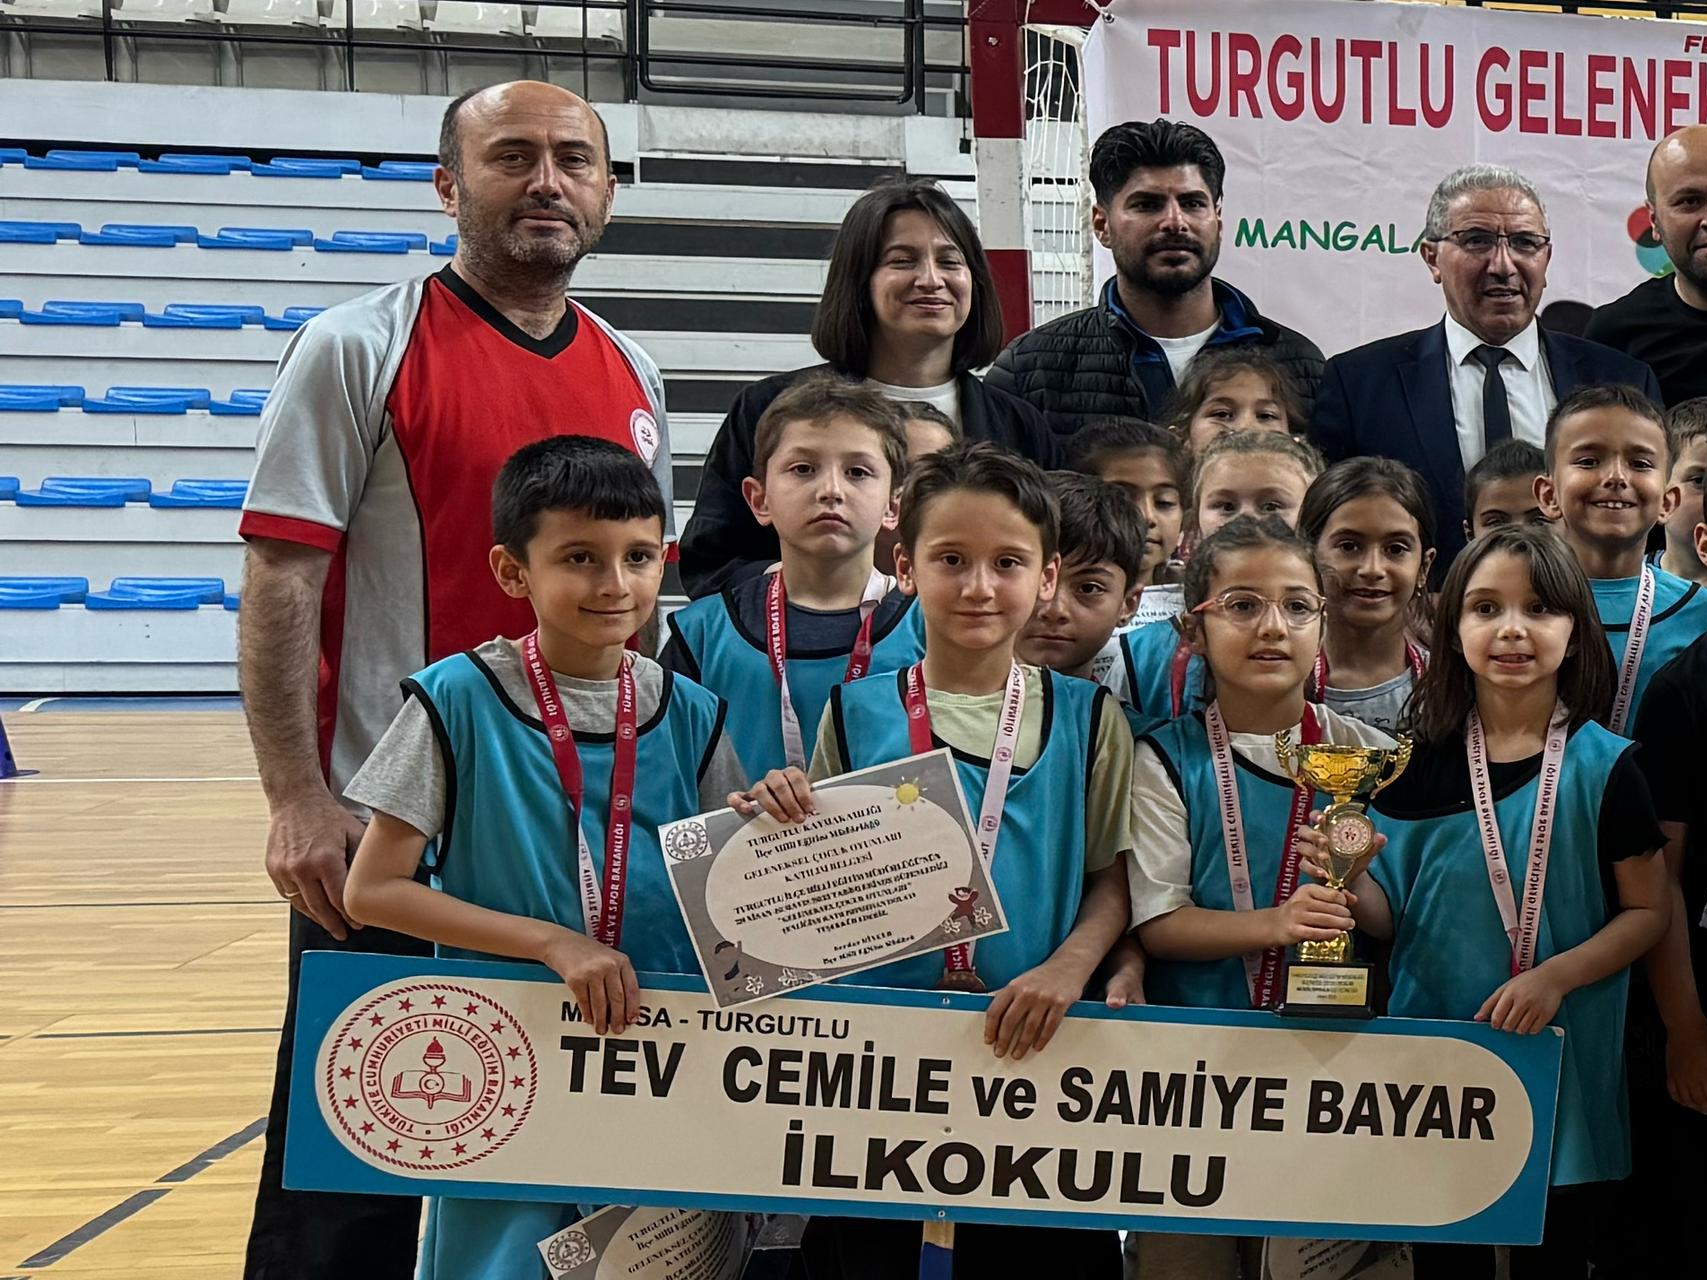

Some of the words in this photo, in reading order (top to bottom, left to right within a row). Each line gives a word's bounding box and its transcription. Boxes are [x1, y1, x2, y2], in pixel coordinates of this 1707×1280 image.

[1147, 28, 1456, 130] TURGUTLU
[431, 1017, 472, 1036] MİLLİ
[562, 1001, 673, 1031] MSA
[697, 1009, 851, 1040] TURGUTLU
[365, 1018, 430, 1089] CUMHURİYETİ
[472, 1028, 500, 1077] EĞİTİM
[365, 1093, 414, 1135] TÜRKİYE
[445, 1079, 500, 1134] BAKANLIĞI
[559, 1034, 686, 1098] TEV
[722, 1040, 952, 1117] CEMİLE
[970, 1075, 1037, 1120] ve
[1056, 1059, 1288, 1132] SAMİYE
[1305, 1079, 1497, 1141] BAYAR
[781, 1119, 1227, 1209] İLKOKULU
